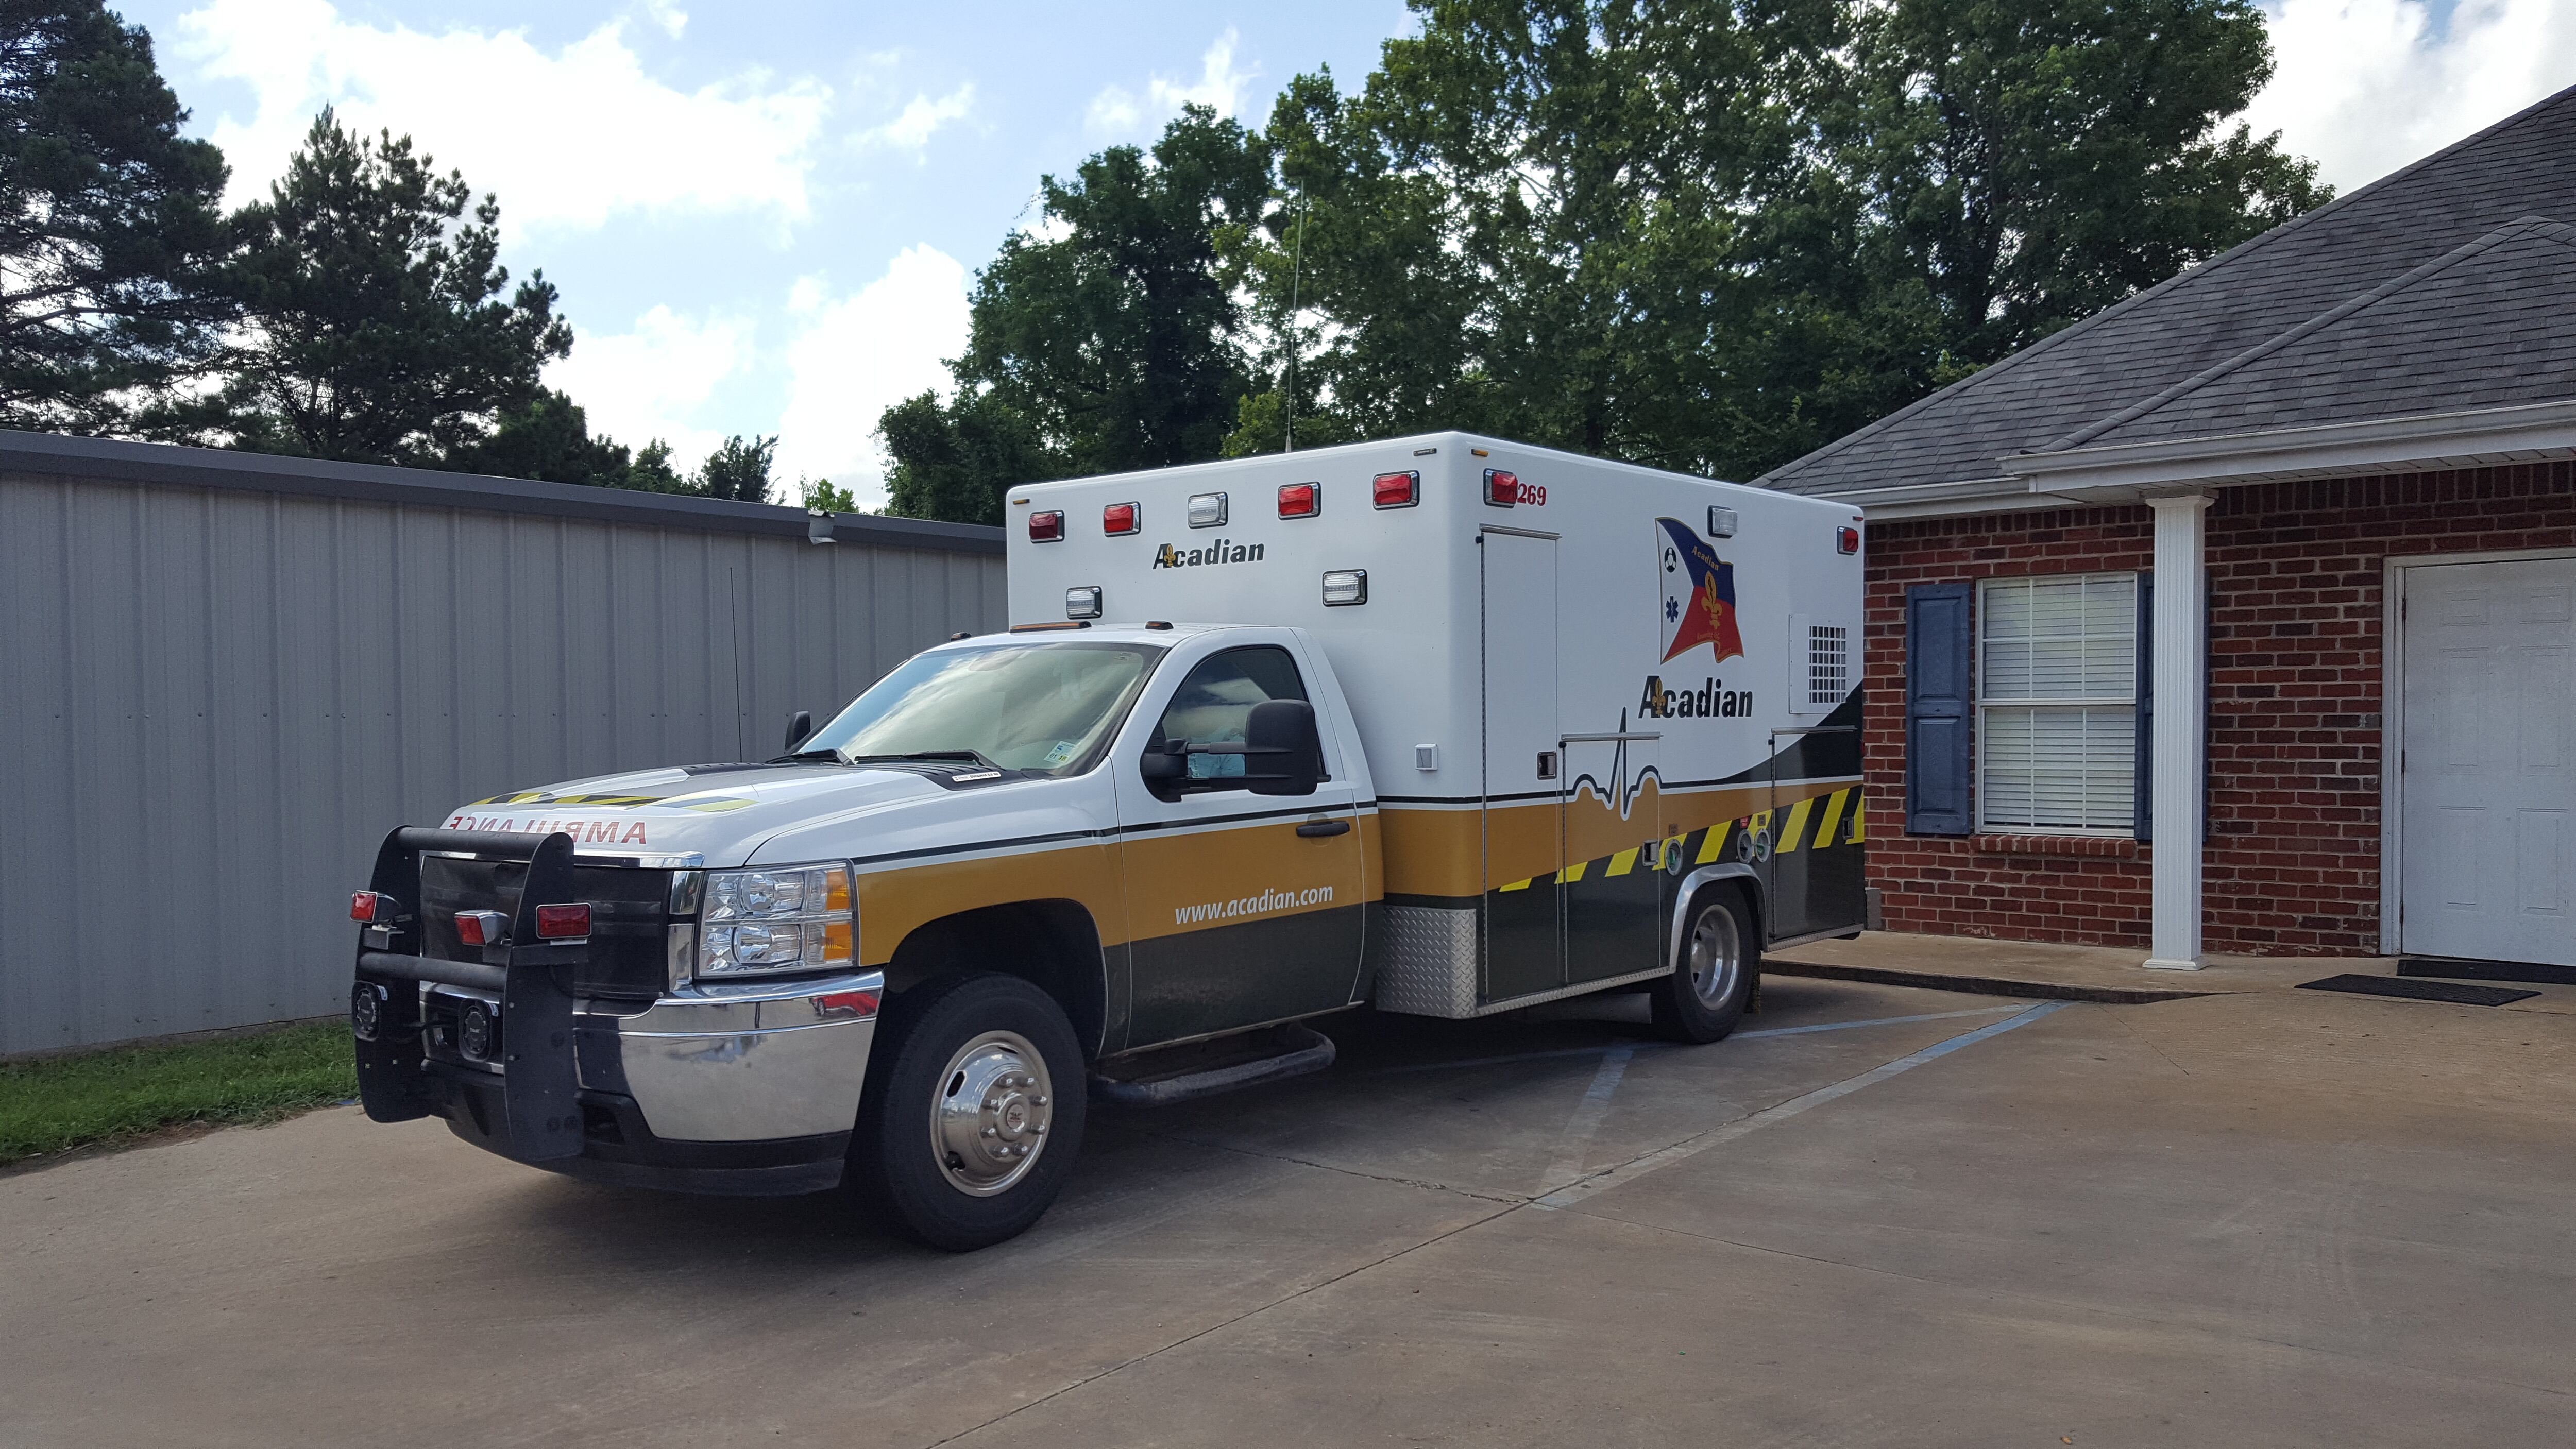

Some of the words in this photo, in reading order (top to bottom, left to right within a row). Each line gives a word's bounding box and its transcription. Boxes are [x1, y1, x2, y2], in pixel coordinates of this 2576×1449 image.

[1517, 483, 1547, 506] 269
[1153, 539, 1264, 569] Acadian
[1692, 545, 1719, 571] Acadian
[1638, 675, 1753, 719] Acadian
[1175, 885, 1333, 924] www.acadian.com
